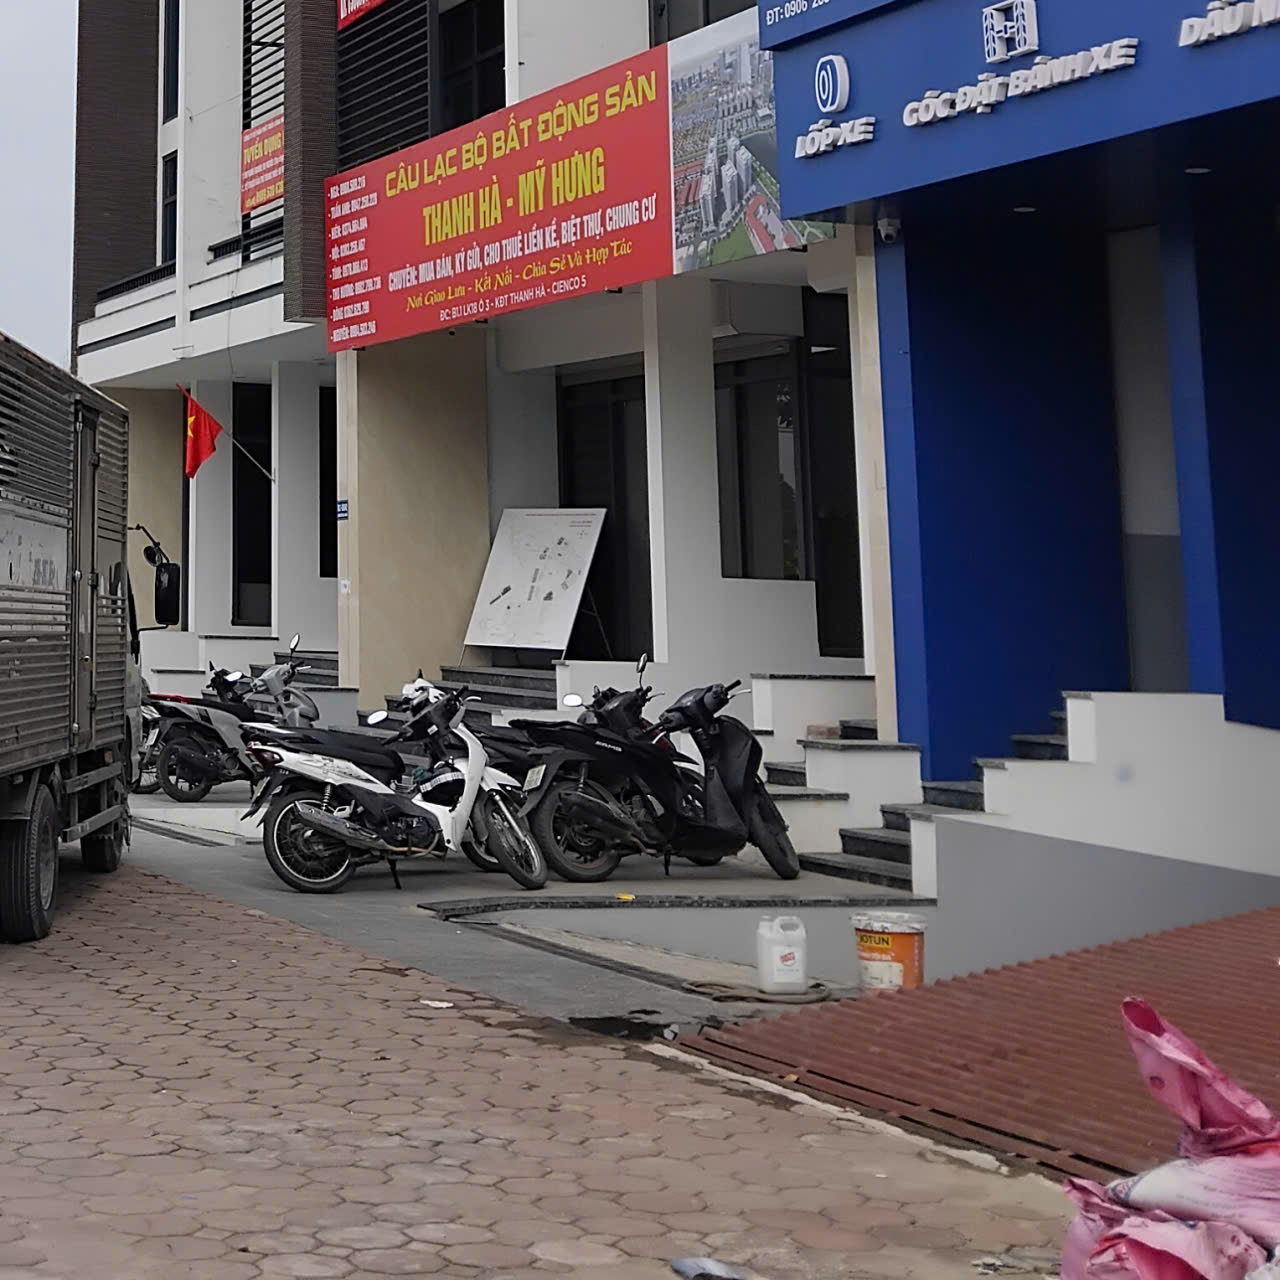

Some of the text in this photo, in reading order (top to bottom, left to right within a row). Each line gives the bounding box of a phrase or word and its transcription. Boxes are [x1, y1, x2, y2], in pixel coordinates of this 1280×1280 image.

[1089, 37, 1139, 73] XE
[385, 161, 420, 198] CÂU
[423, 148, 458, 185] LẠC
[461, 132, 487, 170] BỘ
[492, 112, 533, 160] BẤT
[537, 93, 600, 141] ĐỘNG
[604, 70, 657, 118] SẢN
[795, 116, 876, 159] LỐP XE
[422, 191, 474, 247] THANH
[479, 175, 503, 230] HÀ
[518, 158, 546, 217] MỸ
[551, 146, 606, 208] HƯNG
[455, 248, 466, 274] KÝ
[484, 241, 500, 267] CHO
[502, 230, 523, 260] THUÊ
[524, 222, 544, 255] LIỀN
[561, 216, 582, 248] BIỆT
[605, 197, 640, 232] CHUNG
[641, 193, 657, 221] CƯ
[424, 289, 446, 306] Giao
[474, 276, 492, 294] Kết
[493, 268, 513, 291] Nối
[522, 262, 547, 282] Chia
[567, 251, 583, 269] Và
[585, 245, 609, 267] Hợp
[611, 240, 633, 257] Tác
[495, 294, 508, 309] KĐT
[509, 289, 533, 306] THANH
[534, 284, 546, 300] HÀ
[552, 278, 580, 296] CIENCO
[580, 275, 587, 288] 5
